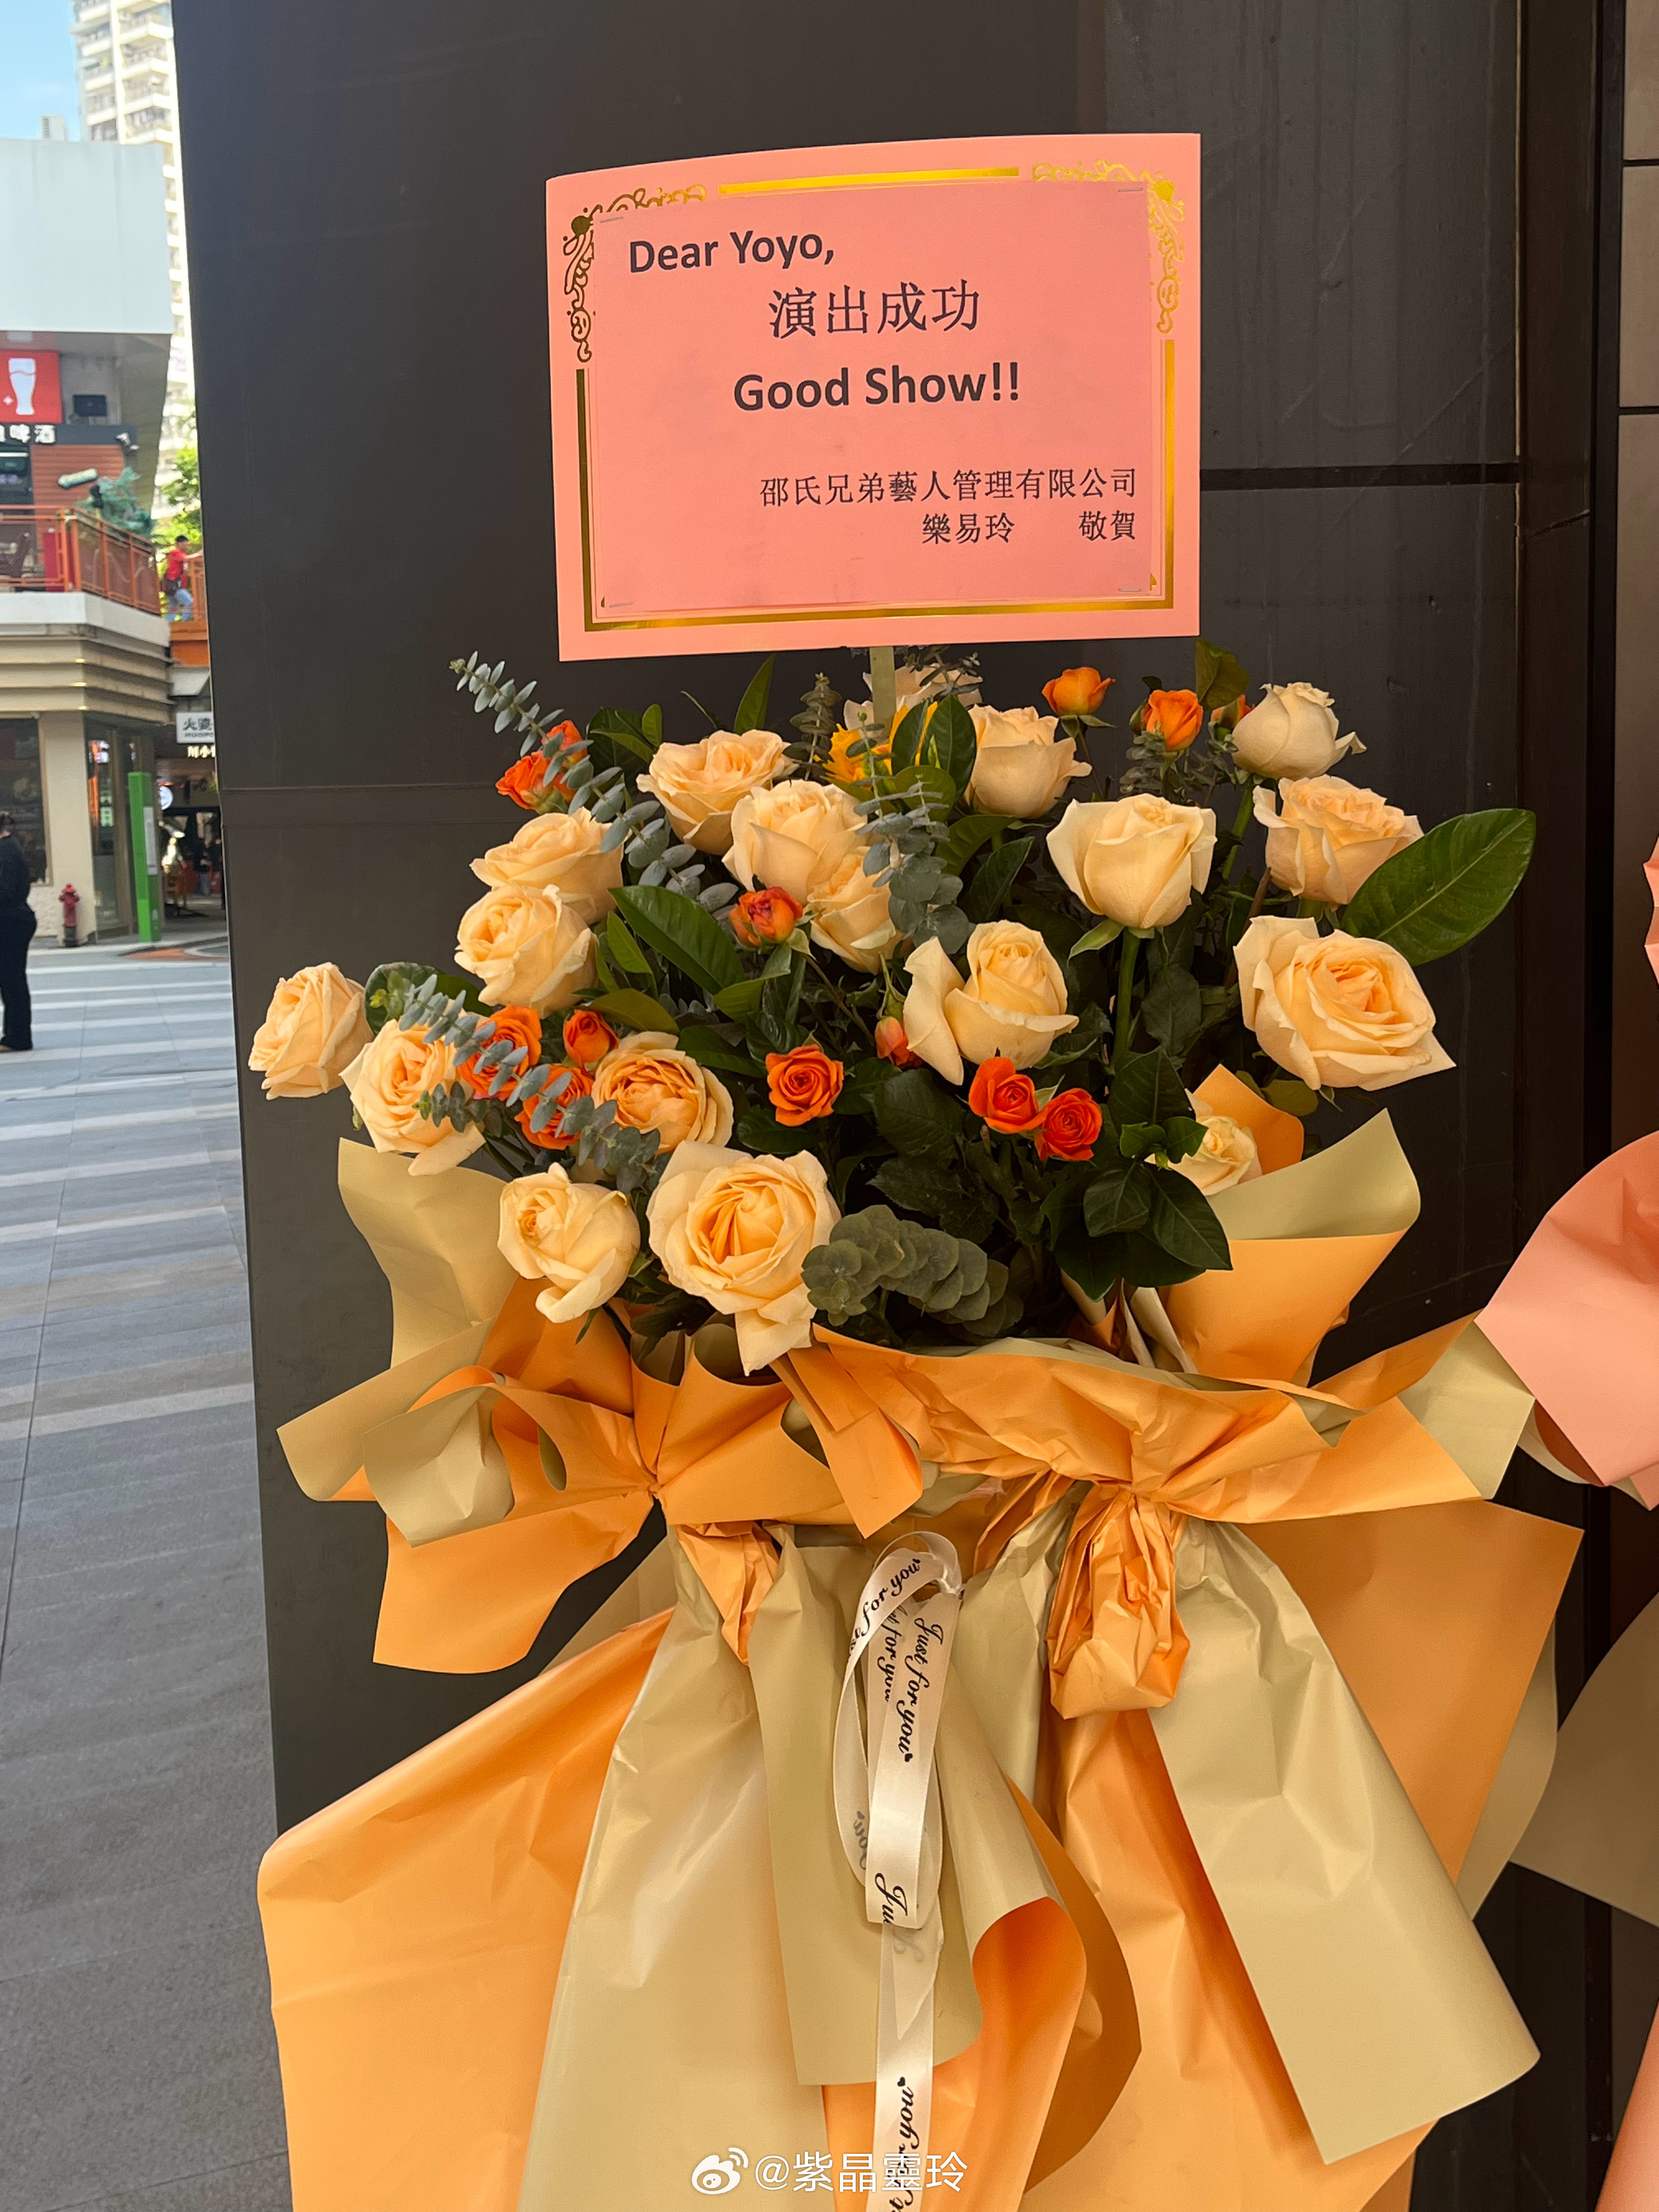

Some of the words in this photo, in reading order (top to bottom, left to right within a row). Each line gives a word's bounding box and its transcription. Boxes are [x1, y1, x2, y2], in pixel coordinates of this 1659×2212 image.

[630, 240, 719, 273] Dear
[729, 230, 834, 269] Yoyo,
[769, 279, 979, 340] 演出成功
[734, 367, 849, 411] Good
[866, 362, 1019, 404] Show!!
[0, 424, 55, 443] 啤酒
[759, 467, 1136, 507] 邵氏兄弟藝人管理有限公司
[922, 512, 1015, 545] 樂易玲
[1078, 510, 1136, 541] 敬賀
[890, 1562, 920, 1596] you
[914, 1617, 944, 1664] Just
[905, 1655, 930, 1706] for
[896, 1700, 915, 1753] you
[899, 2086, 920, 2149] you
